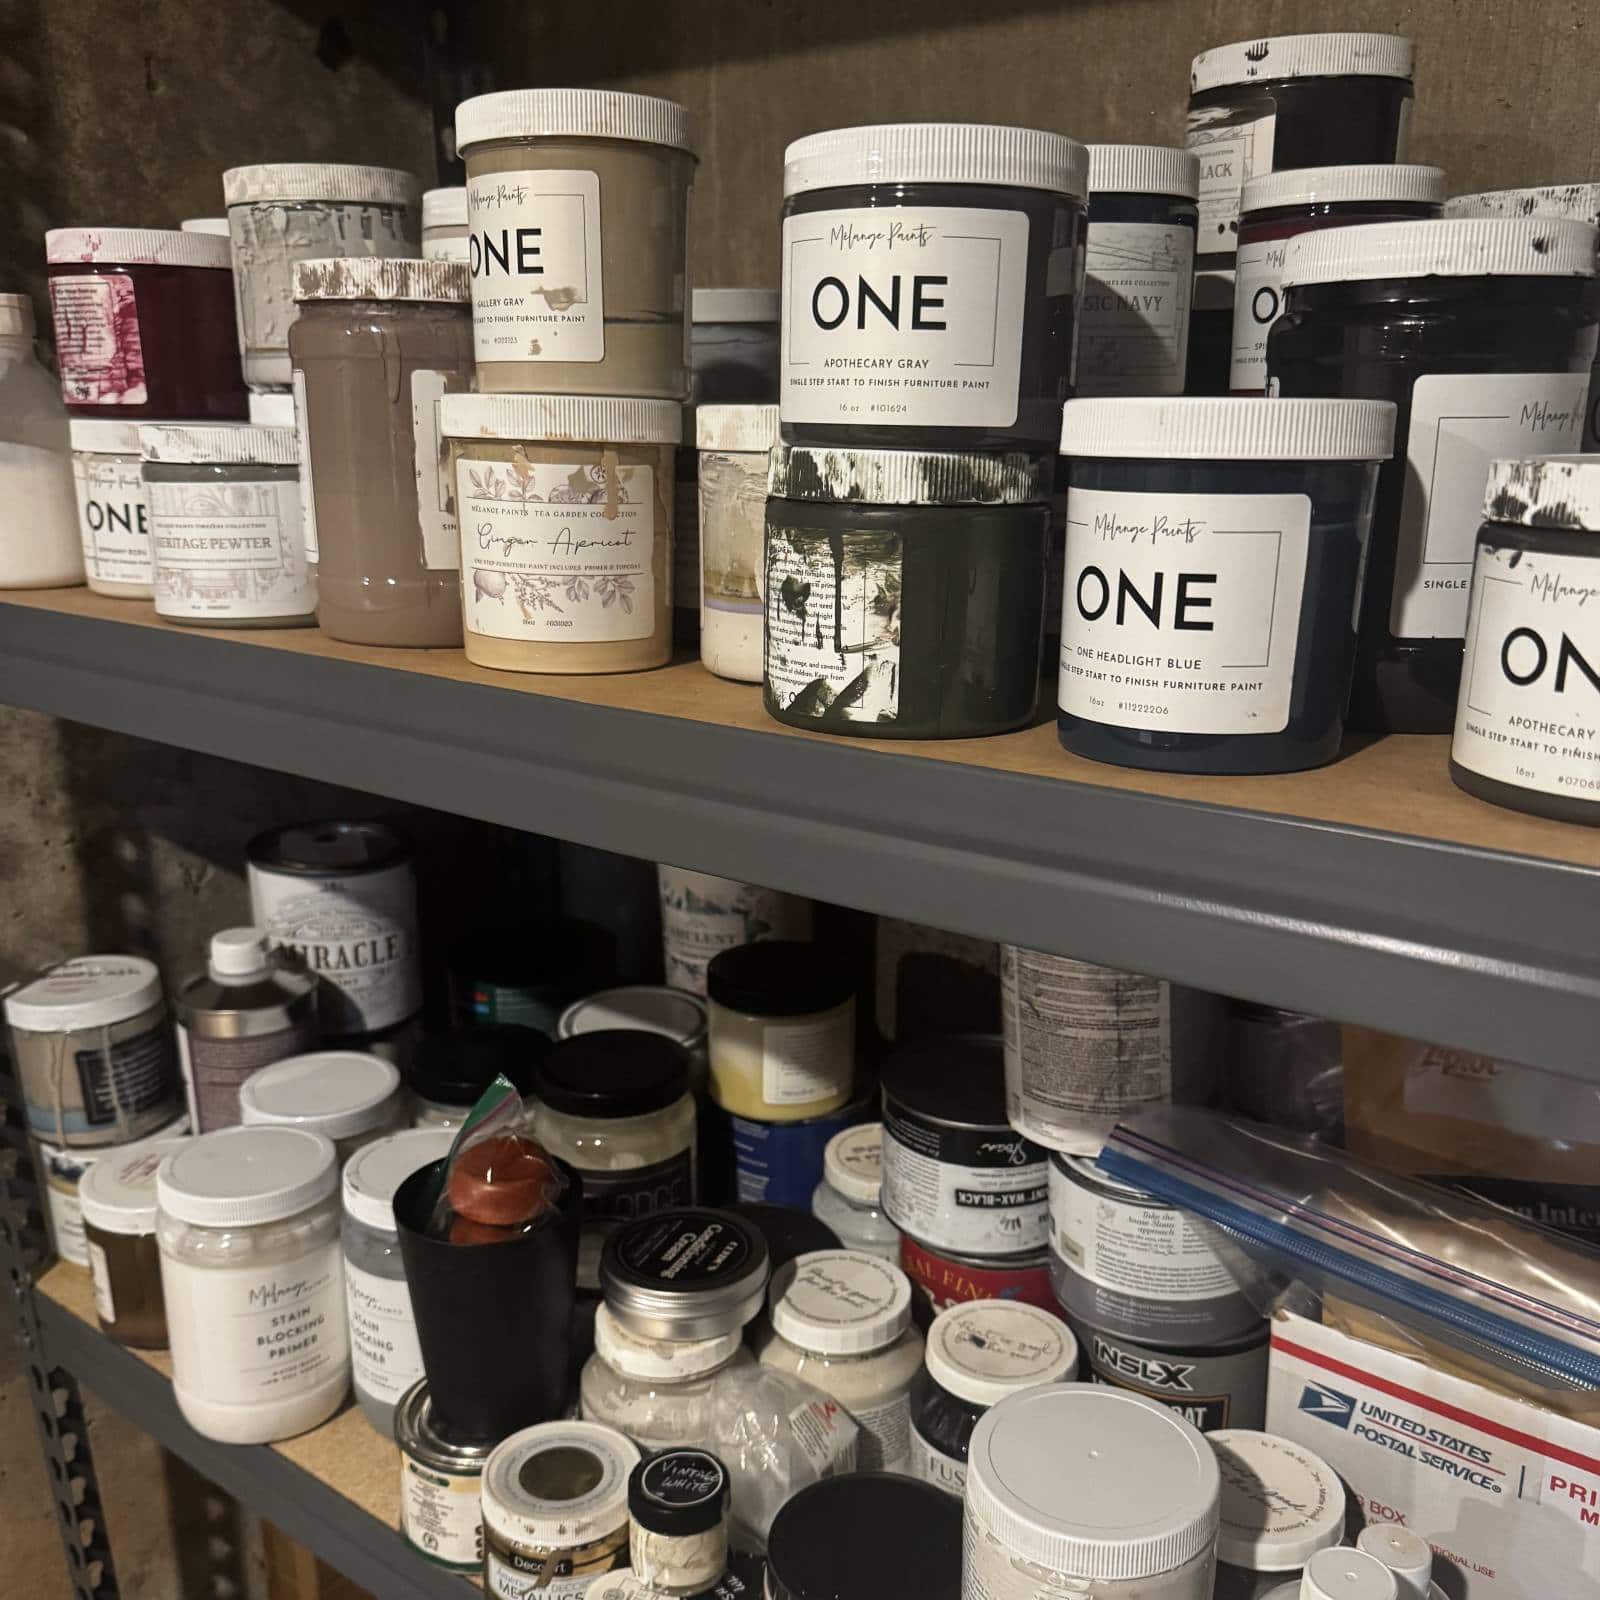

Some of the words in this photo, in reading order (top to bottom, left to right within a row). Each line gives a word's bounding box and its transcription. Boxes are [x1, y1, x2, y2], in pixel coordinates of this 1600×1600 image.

[1200, 161, 1233, 179] LACK
[470, 228, 545, 278] ONE
[504, 298, 524, 306] GRAY
[812, 274, 948, 331] ONE
[516, 315, 558, 323] FURNITURE
[561, 315, 586, 323] PAINT
[824, 358, 893, 369] APOTHECARY
[898, 359, 929, 369] GRAY
[790, 378, 808, 386] SINGLE
[809, 378, 825, 386] STEP
[827, 378, 850, 386] START
[854, 378, 865, 387] TO
[868, 379, 900, 387] FINISH
[904, 379, 958, 388] FURNITURE
[962, 380, 990, 389] PAINT
[840, 403, 848, 412] 16
[86, 500, 148, 534] ONE
[590, 510, 638, 518] COLCTION
[210, 537, 272, 550] PEWTER
[477, 522, 538, 558] Ginger
[547, 527, 636, 555] Apricot
[1424, 580, 1467, 589] SINGLE
[1077, 565, 1217, 631] ONE
[1077, 646, 1094, 659] ONE
[1097, 650, 1162, 668] HEADLIGHT
[1167, 658, 1202, 670] BLUE
[1071, 665, 1084, 677] STEP
[1085, 669, 1107, 681] START
[1110, 673, 1122, 684] TO
[1125, 676, 1159, 689] FINISH
[1163, 679, 1226, 692] FURNITURE
[1231, 682, 1263, 692] PAINT
[1508, 716, 1596, 740] APOTHECARY
[1488, 731, 1508, 743] STEP
[1510, 738, 1539, 751] START
[1544, 744, 1558, 755] TO
[271, 1306, 311, 1328] STAIN
[257, 1315, 325, 1347] BLOCKING
[269, 1334, 319, 1359] PRIMER
[1353, 1423, 1417, 1460] POSTAL
[1360, 1401, 1426, 1436] UNITED
[1428, 1428, 1493, 1464] STATES
[1550, 1475, 1598, 1507] PRI
[1370, 1499, 1406, 1527] BOX
[514, 1555, 568, 1575] Decort
[1473, 1562, 1496, 1579] USE
